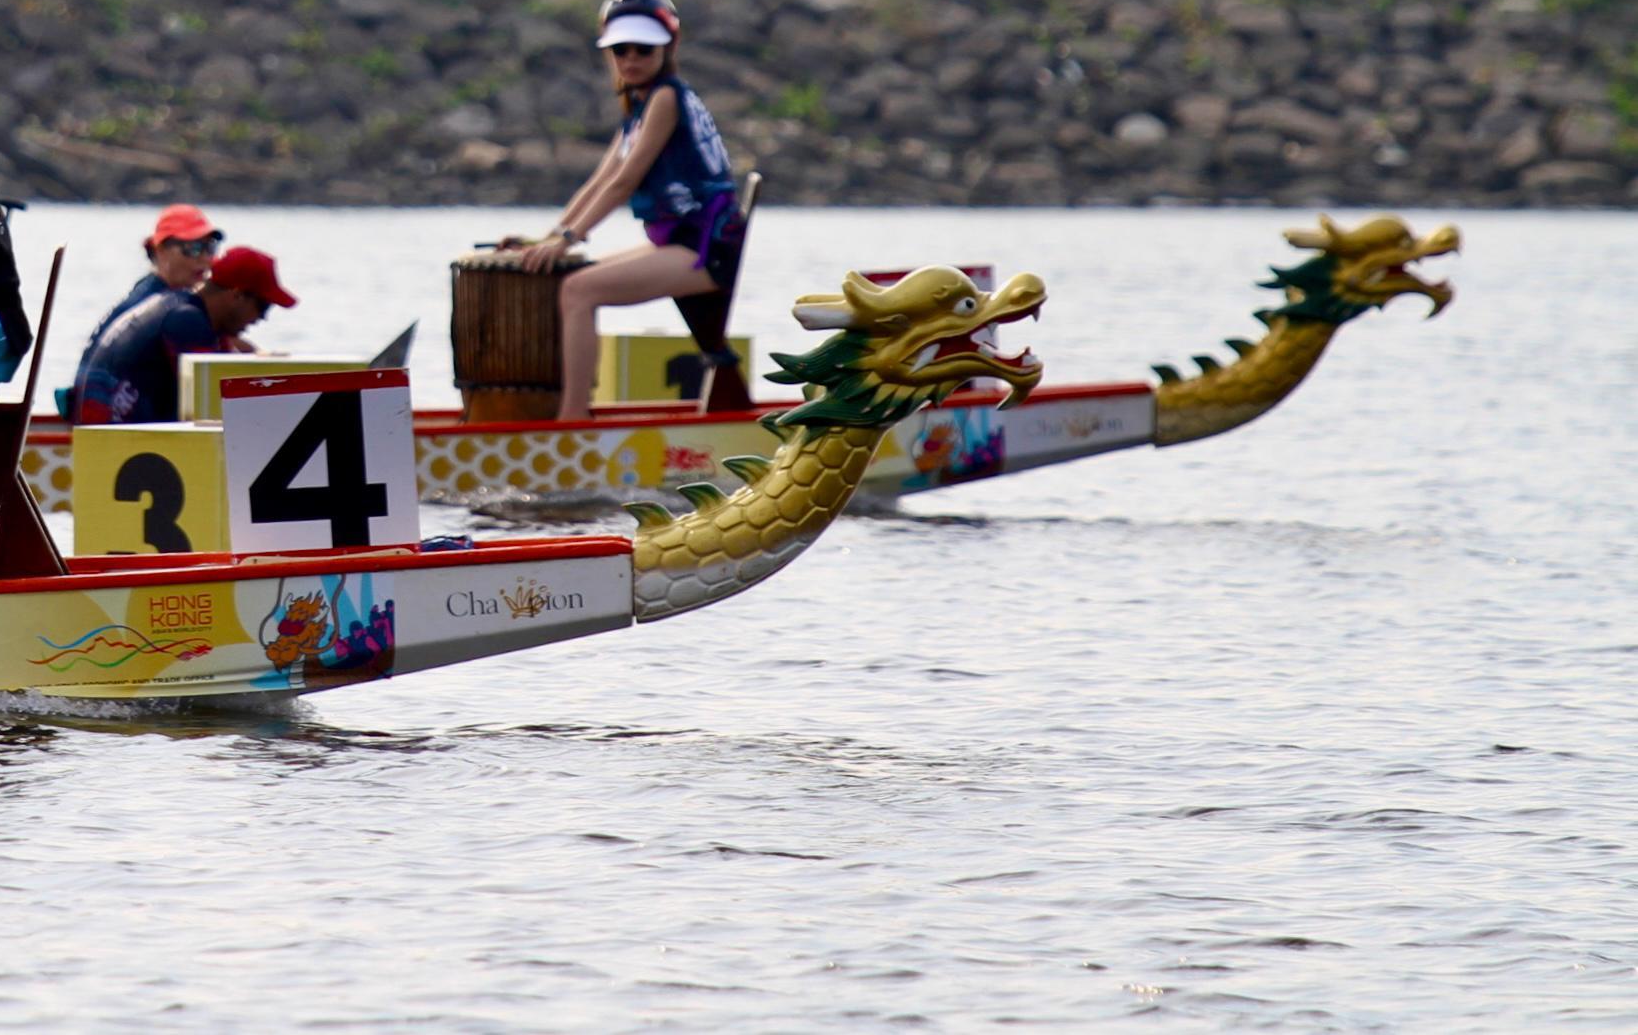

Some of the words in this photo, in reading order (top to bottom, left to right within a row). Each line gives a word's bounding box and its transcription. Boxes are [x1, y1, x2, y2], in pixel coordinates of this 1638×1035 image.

[248, 390, 389, 547] 4
[105, 451, 192, 554] 3
[149, 593, 212, 612] HONG
[150, 609, 213, 628] KONG
